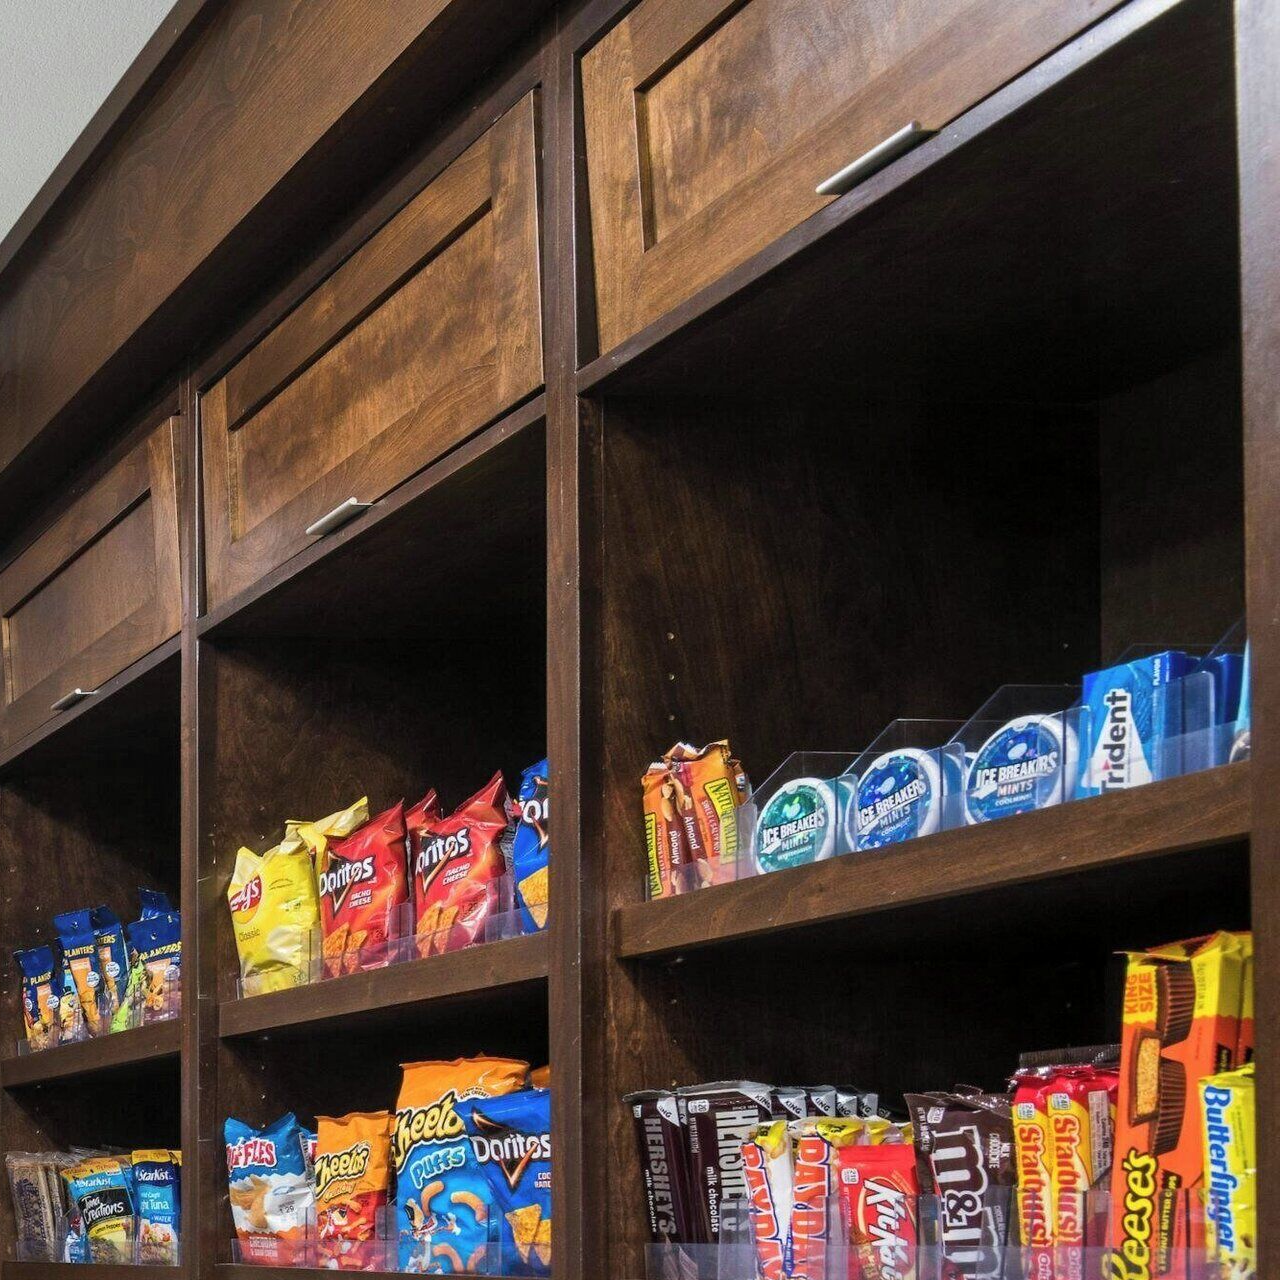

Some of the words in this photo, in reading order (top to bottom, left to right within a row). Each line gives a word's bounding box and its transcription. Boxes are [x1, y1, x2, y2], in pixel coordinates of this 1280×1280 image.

[1099, 689, 1128, 795] Trident
[976, 767, 997, 789] ICE
[997, 751, 1058, 784] BREAKERS
[857, 807, 876, 830] ICE
[875, 777, 926, 818] BREAKERS
[997, 781, 1034, 798] MINTS
[763, 826, 780, 846] ICE
[780, 808, 825, 840] BREAKERS
[880, 805, 911, 828] MINTS
[669, 830, 680, 864] Almond
[684, 816, 700, 850] Almond
[781, 835, 809, 851] MINTS
[319, 856, 376, 897] Doritos
[442, 870, 468, 885] CHEESE
[445, 862, 470, 877] NACHO
[349, 895, 372, 909] CHEESE
[350, 889, 371, 901] NACHO
[239, 927, 261, 942] Classic
[64, 944, 96, 958] PLANTERS
[139, 941, 182, 962] PLANTERS
[1124, 975, 1139, 1014] KING
[1138, 971, 1154, 1014] SIZE
[754, 1094, 771, 1110] KING
[470, 1134, 551, 1163] Doritos
[137, 1168, 169, 1182] StarKist
[315, 1143, 370, 1200] Cheetos
[410, 1147, 466, 1188] PUFFS
[643, 1117, 677, 1234] HERSHEY'S
[706, 1166, 718, 1187] milk
[1053, 1114, 1083, 1243] Starburst
[1203, 1085, 1237, 1252] Butterfinger
[1018, 1124, 1052, 1248] Starburst
[82, 1196, 101, 1211] Tuna
[82, 1200, 124, 1225] Creations
[149, 1200, 170, 1211] Tuna
[647, 1189, 657, 1233] chocolate
[708, 1187, 721, 1233] chocolate
[1160, 1201, 1173, 1235] BUTTER
[105, 1223, 121, 1231] Pepper
